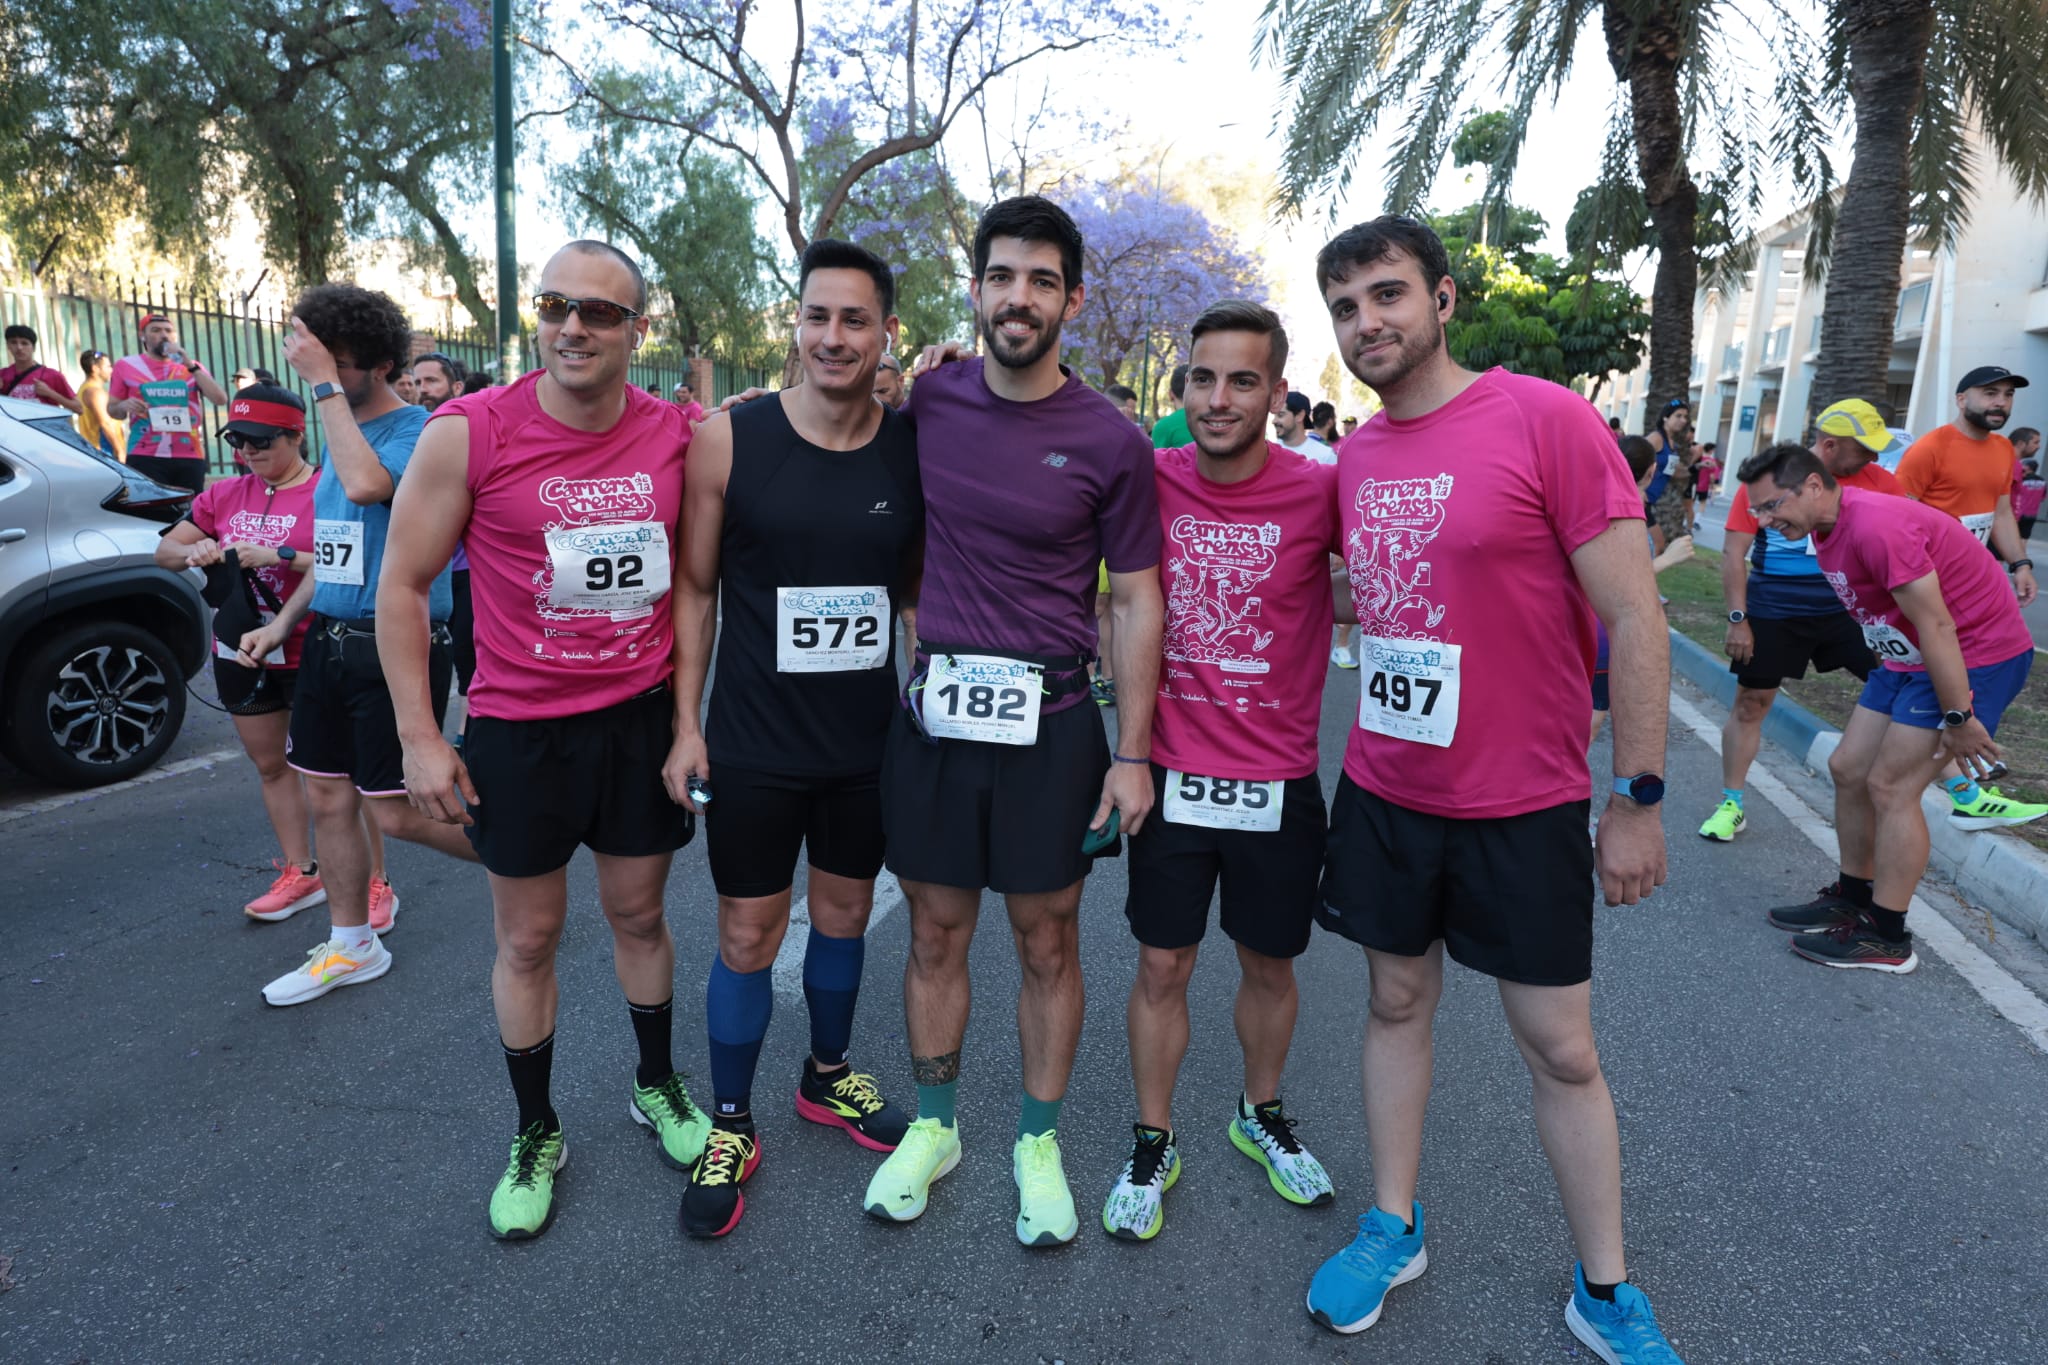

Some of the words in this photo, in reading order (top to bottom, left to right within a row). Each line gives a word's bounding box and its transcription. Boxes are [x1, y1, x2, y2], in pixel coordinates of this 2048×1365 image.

[161, 415, 182, 425] 19
[547, 478, 636, 500] Carrera
[1360, 479, 1432, 504] Carrera
[563, 492, 645, 512] Prensa
[1366, 497, 1434, 518] Prensa
[573, 531, 639, 547] Carrera
[1177, 520, 1261, 542] Carrera
[1190, 539, 1265, 558] Prensa
[586, 555, 643, 590] 92
[801, 592, 862, 607] Carrera
[792, 616, 878, 649] 572
[1372, 644, 1425, 665] Carrera
[937, 684, 1026, 721] 182
[1369, 671, 1443, 716] 497
[1179, 775, 1270, 809] 585
